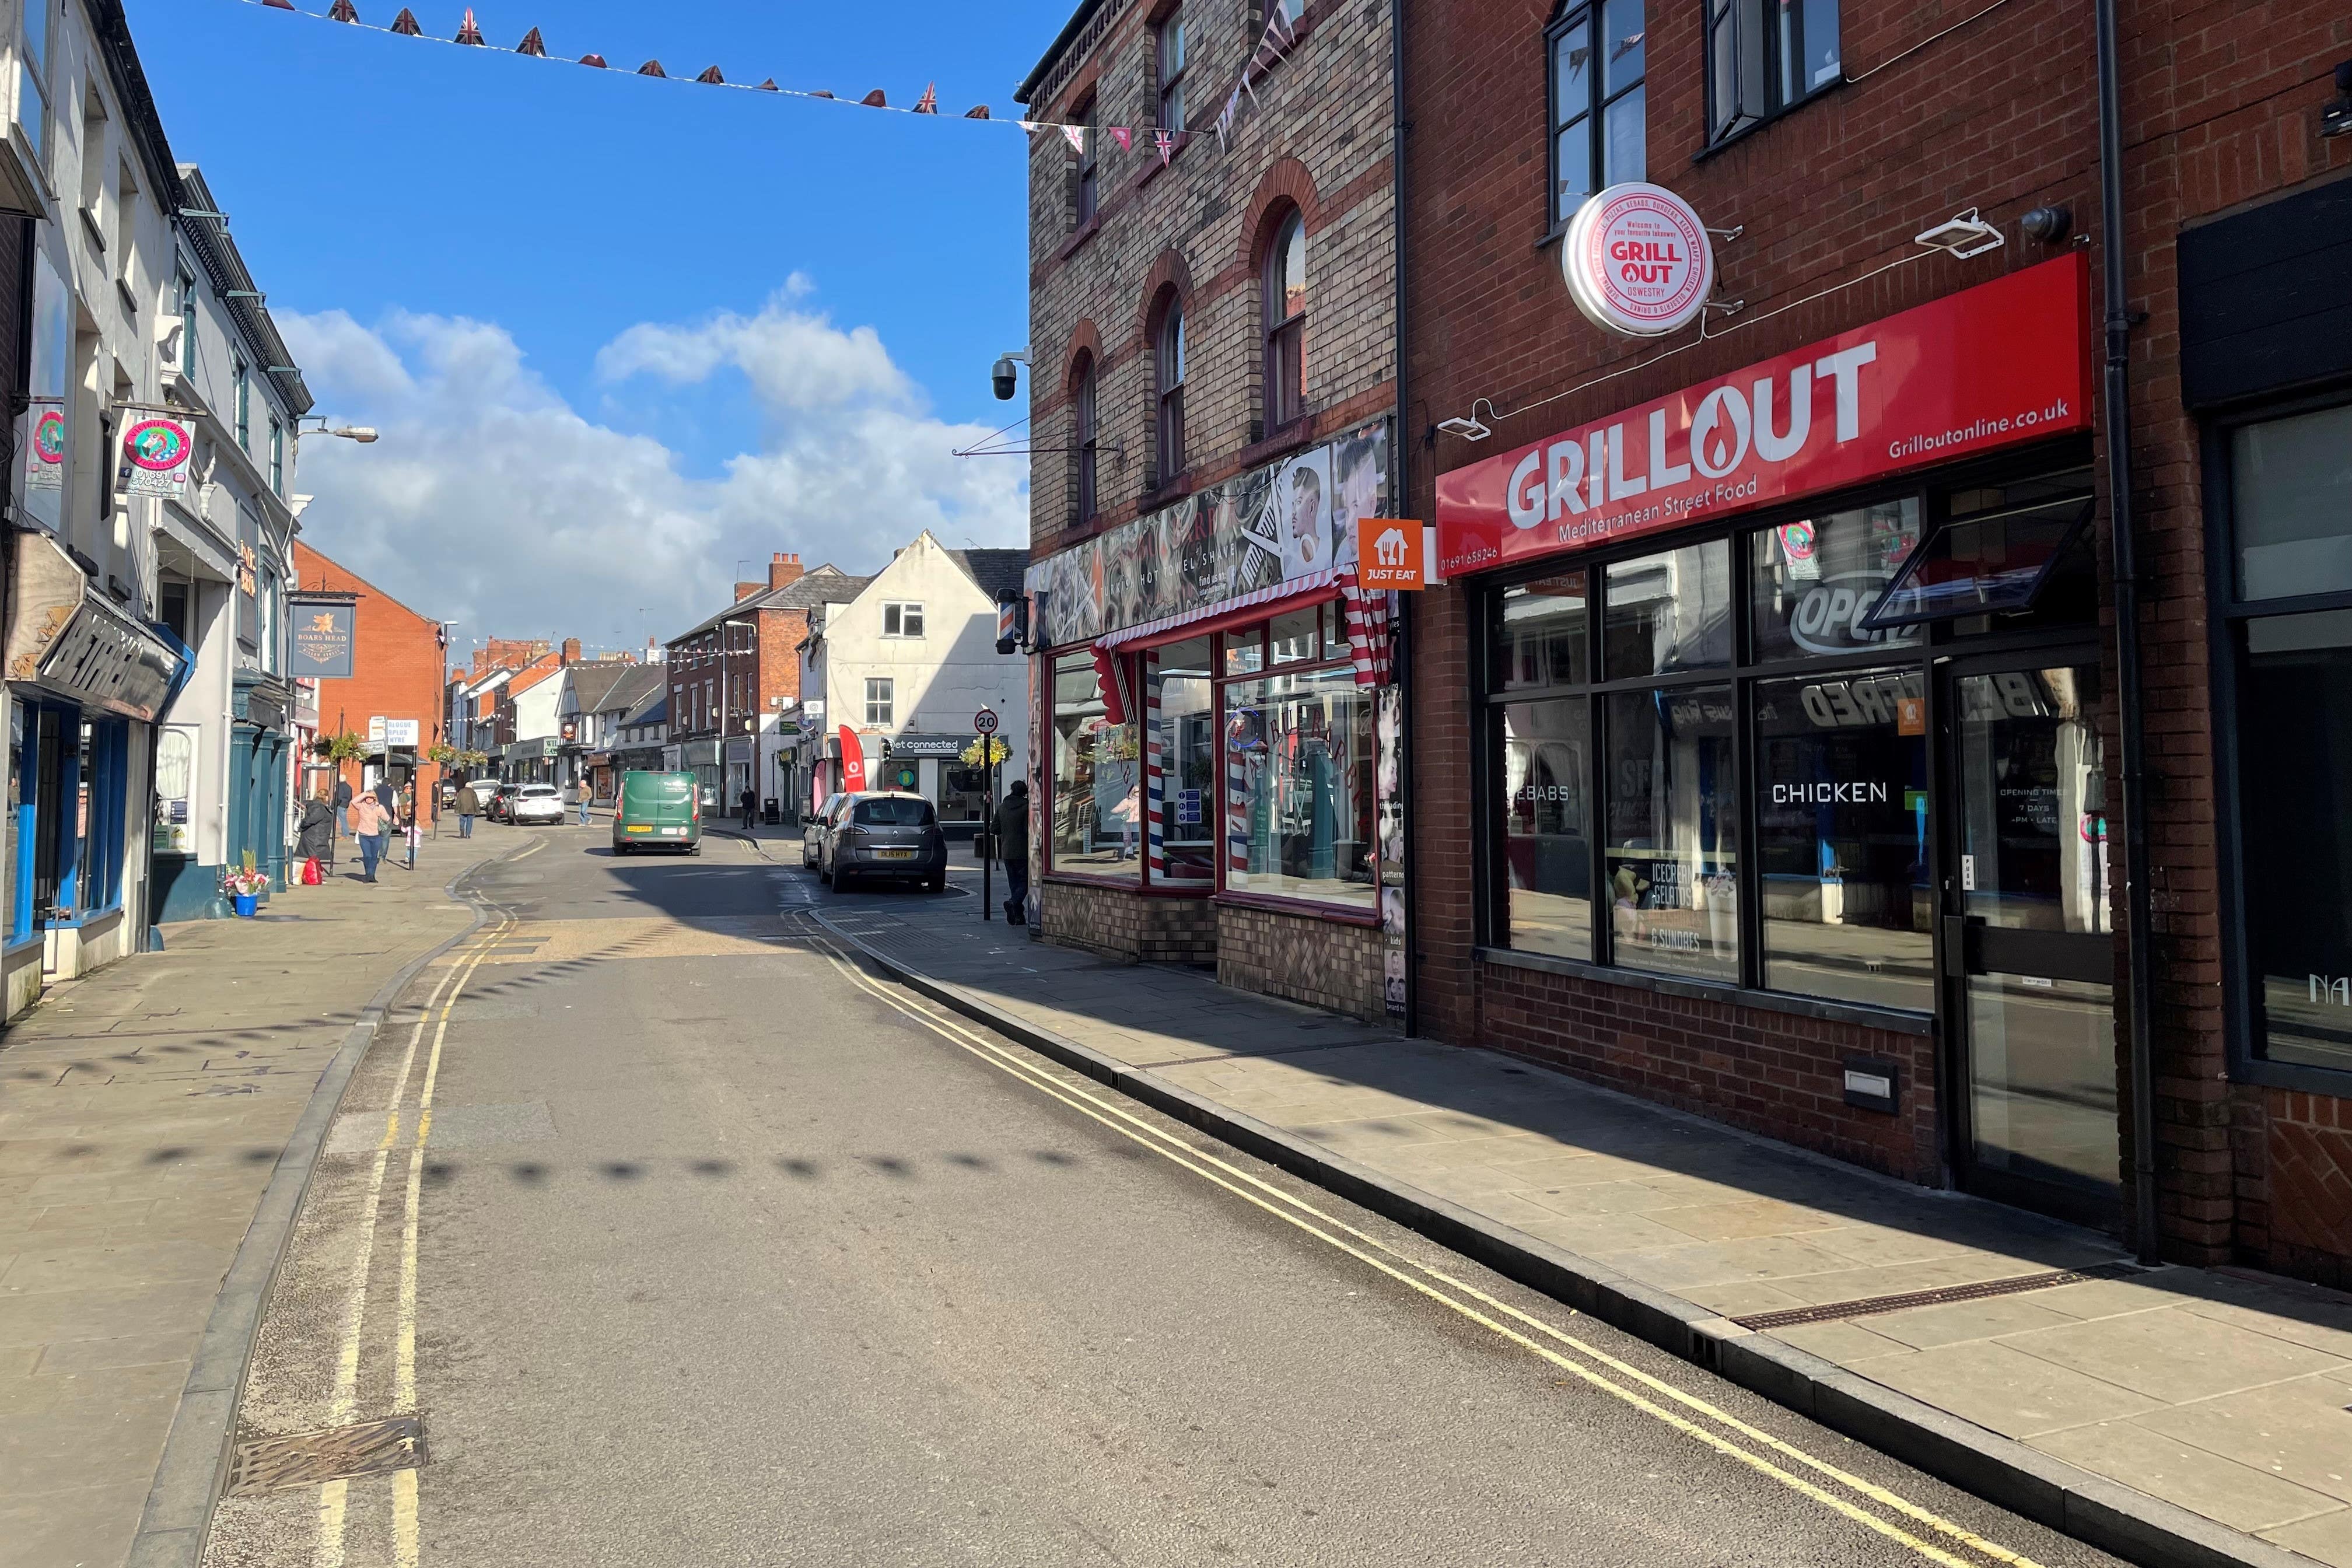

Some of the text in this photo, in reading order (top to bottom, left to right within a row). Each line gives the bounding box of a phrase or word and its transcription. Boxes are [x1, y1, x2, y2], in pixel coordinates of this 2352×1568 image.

[1611, 240, 1682, 262] GRILL
[1621, 262, 1673, 284] OUT
[1628, 286, 1665, 297] OSWESTRY
[130, 421, 167, 438] VICIOUS
[1889, 397, 2069, 459] Grilloutonline.co.uk
[131, 477, 172, 488] 570427
[136, 469, 169, 480] 01691
[1558, 474, 1758, 542] Mediterranean Street Food
[1140, 569, 1158, 586] HOT
[1163, 557, 1195, 578] TOWEL
[1202, 542, 1236, 566] SHAVE
[1441, 547, 1497, 570] 01691 658246
[1199, 573, 1210, 587] find
[1211, 574, 1218, 583] us
[1367, 569, 1417, 580] JUST EAT
[978, 717, 995, 727] 20
[907, 740, 958, 749] connected
[1516, 785, 1569, 802] EBABS
[1773, 782, 1887, 803] CHICKEN
[1382, 871, 1405, 880] patterns
[1654, 884, 1692, 907] GELATOS
[1390, 936, 1401, 946] kids
[2309, 974, 2352, 1006] NA
[1386, 1002, 1399, 1013] beard
